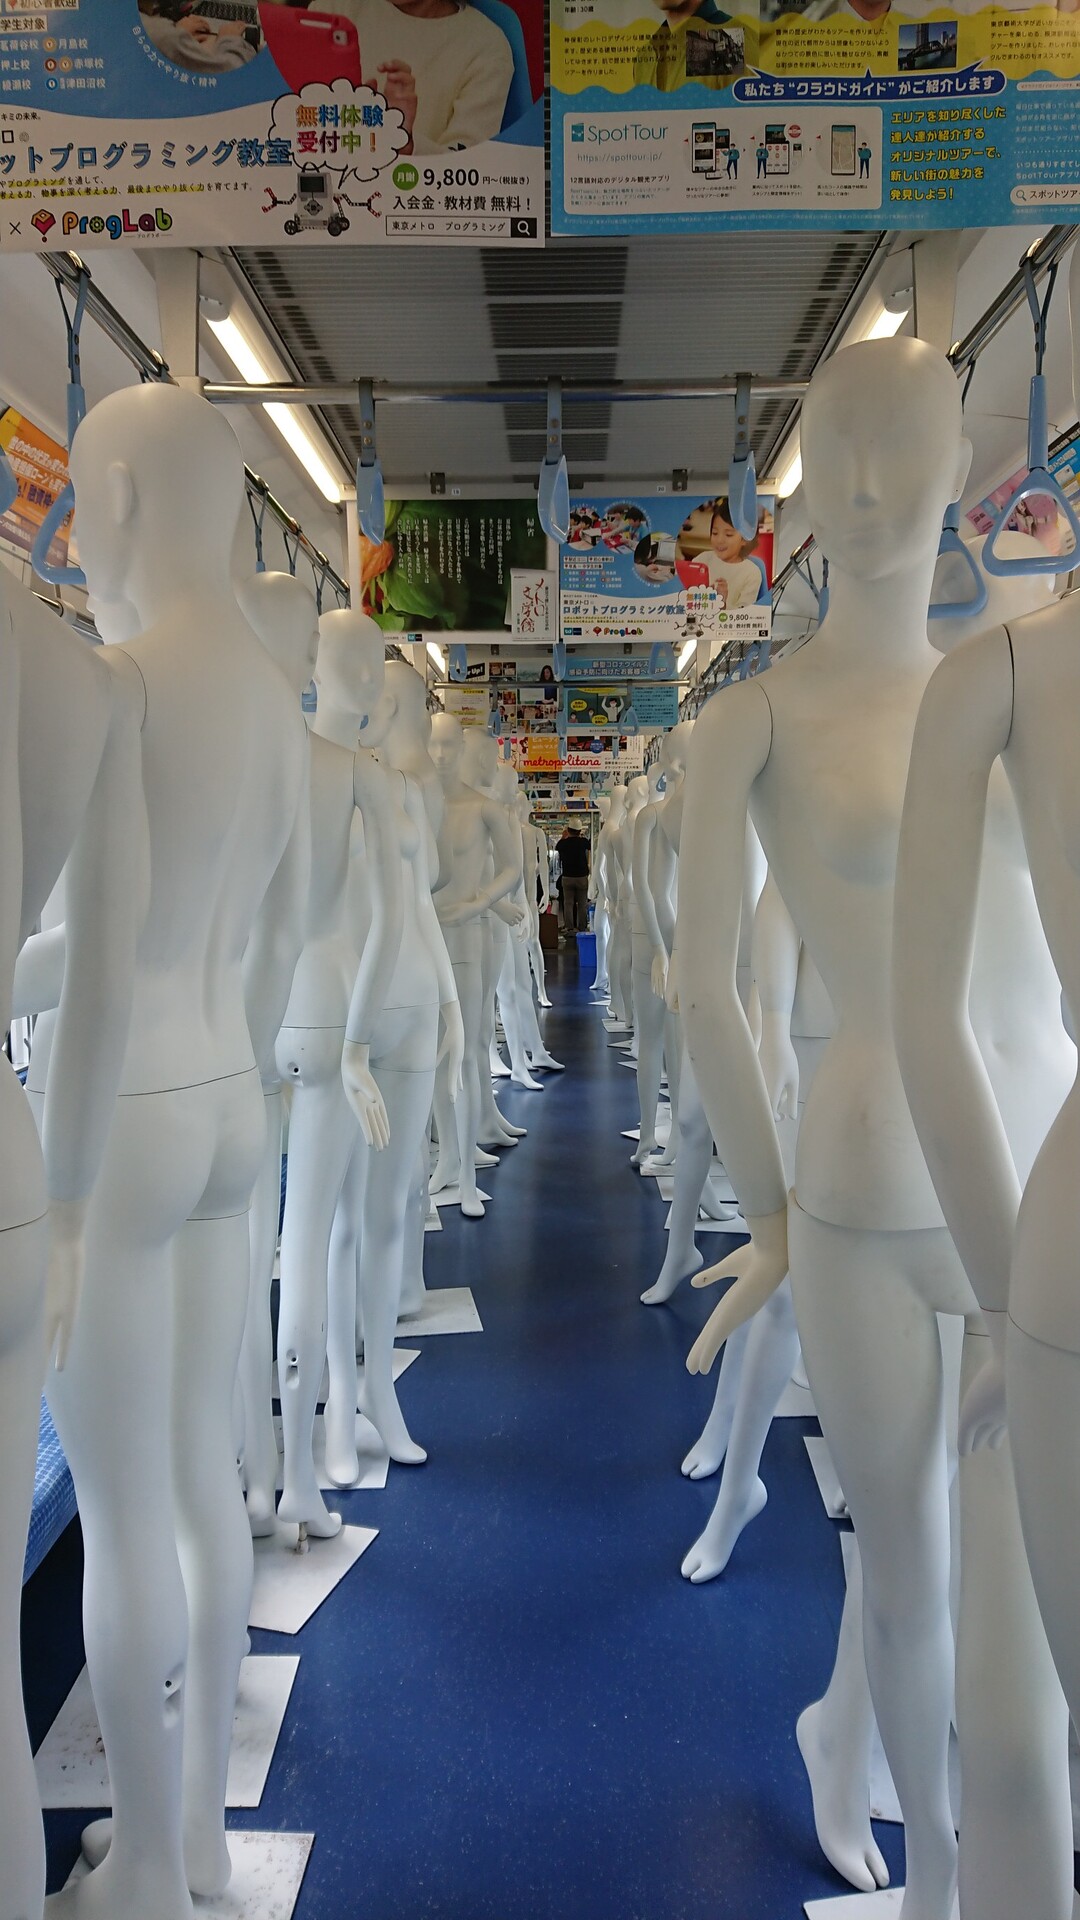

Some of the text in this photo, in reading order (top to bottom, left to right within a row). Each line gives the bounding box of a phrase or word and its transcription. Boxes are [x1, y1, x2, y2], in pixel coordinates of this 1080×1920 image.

[296, 104, 384, 128] 無料体験
[890, 106, 1007, 124] エリアを知り尽くした
[297, 131, 377, 154] 受付中！
[890, 127, 986, 144] 達人達が紹介する
[0, 138, 292, 175] ットプログラミング教室
[577, 151, 663, 163] https://spottour.jp/
[890, 146, 1002, 163] オリジナルツアーで、
[423, 168, 480, 190] 9,800
[890, 166, 985, 182] 新しい街の魅力を
[890, 187, 955, 201] 発見しよう！
[1029, 189, 1080, 199] スポットツア
[62, 207, 173, 240] ProgLab
[391, 221, 506, 233] 東京メトロ プログラミング
[526, 517, 535, 537] 帰省
[686, 593, 717, 601] 無料体験
[563, 604, 686, 615] ロボットプログラミング教室
[729, 614, 749, 622] 9,800
[604, 627, 644, 636] ProgLab
[523, 754, 601, 770] metropolitana
